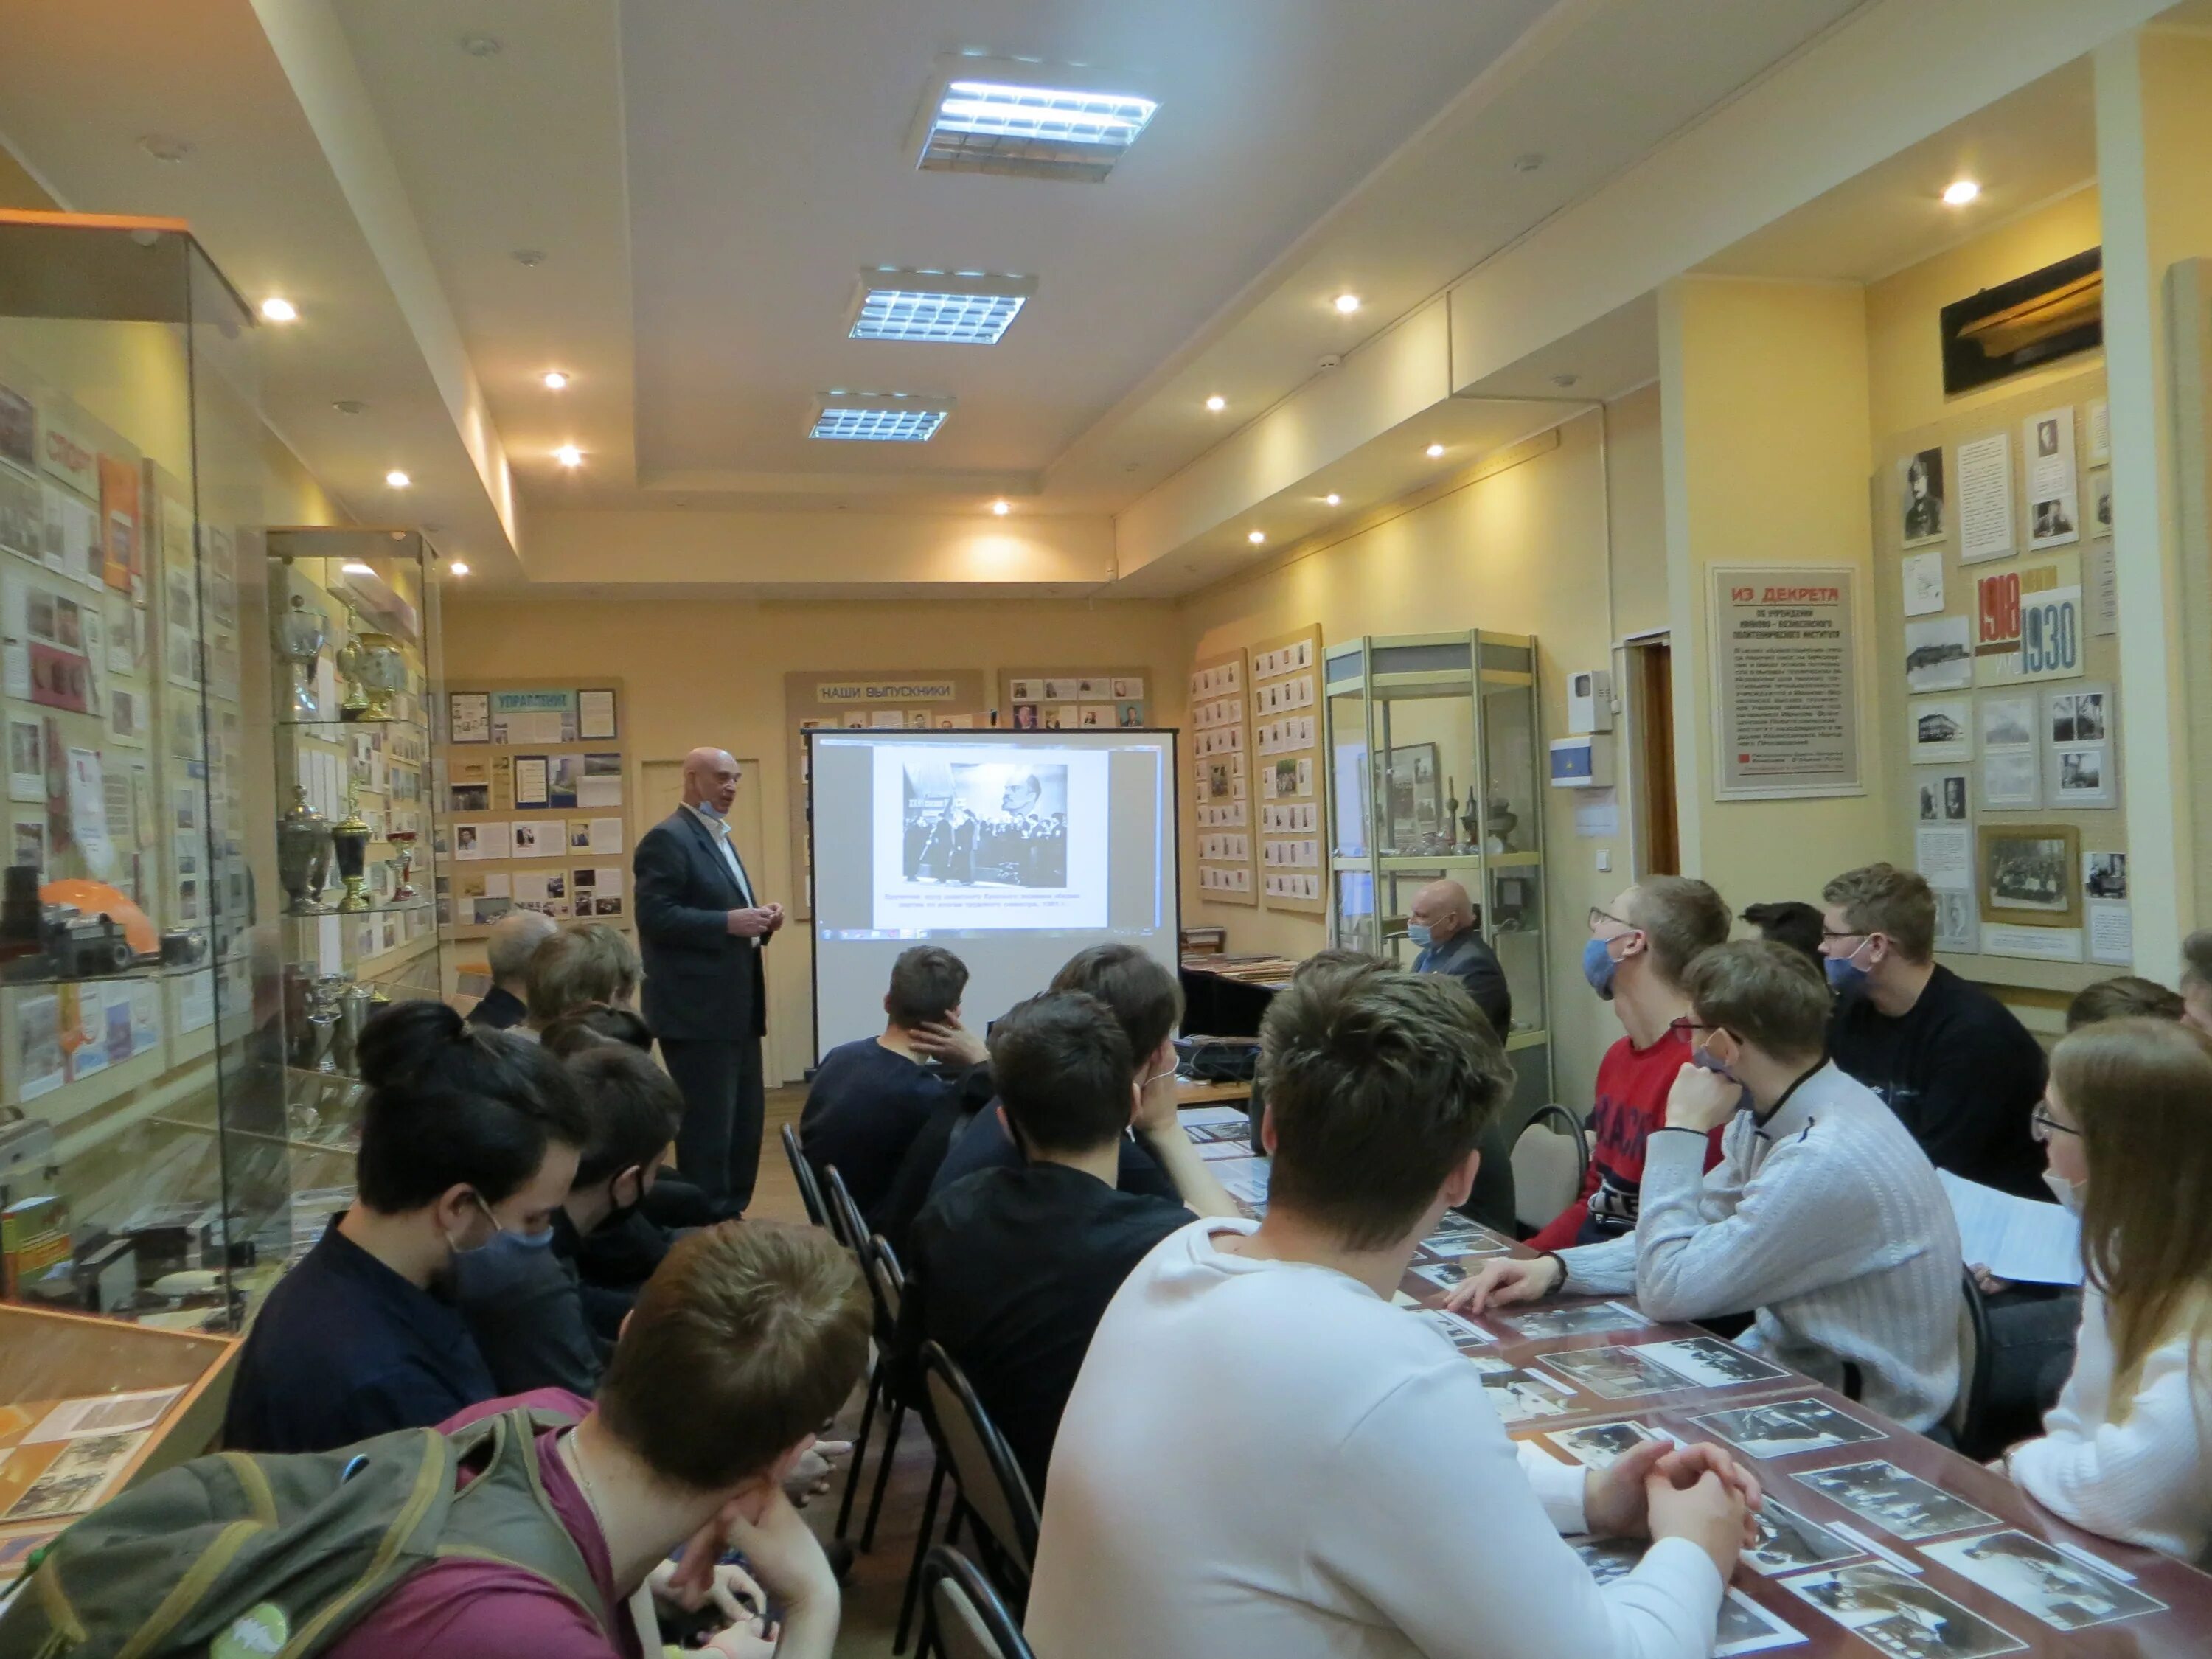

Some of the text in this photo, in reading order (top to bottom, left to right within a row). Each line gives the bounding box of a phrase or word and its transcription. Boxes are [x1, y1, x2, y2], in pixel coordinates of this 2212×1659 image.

[1731, 587, 1839, 603] ИЗ ДЕКРЕТА
[1978, 572, 2020, 642] 1918
[2021, 602, 2076, 675] 1930
[822, 684, 950, 698] НАШИ ВЫПУСКНИКИ
